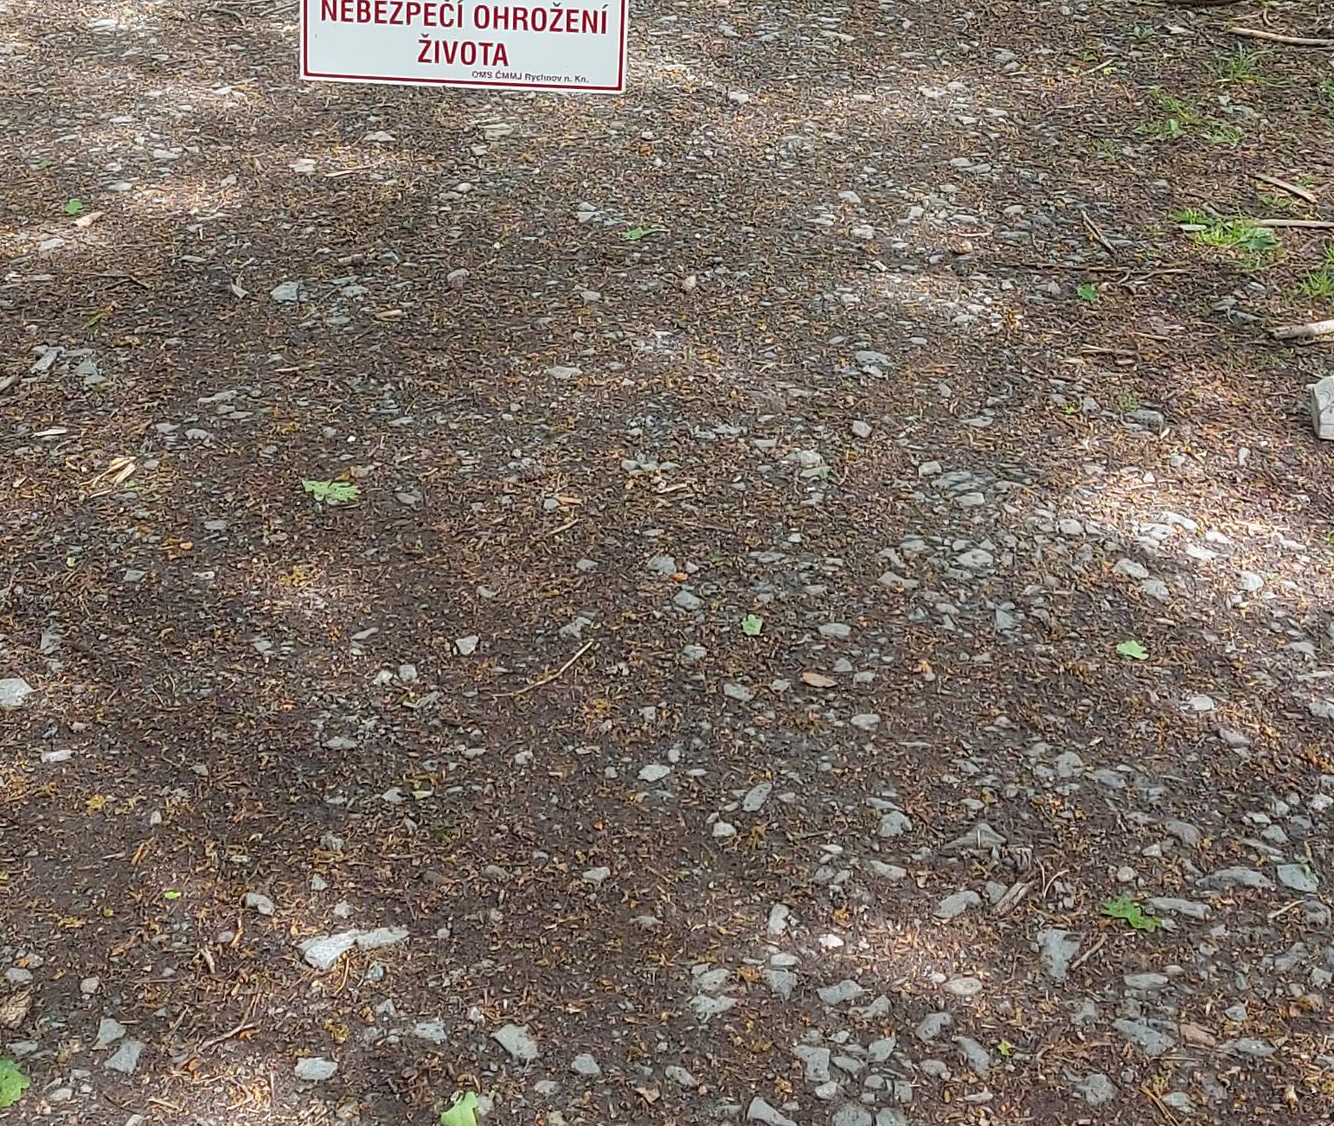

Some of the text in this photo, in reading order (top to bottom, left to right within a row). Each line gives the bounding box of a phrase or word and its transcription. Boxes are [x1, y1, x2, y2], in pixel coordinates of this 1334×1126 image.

[473, 2, 609, 35] OHROŽENÍ
[417, 33, 509, 67] ŽIVOTA
[524, 73, 562, 83] Rychnov
